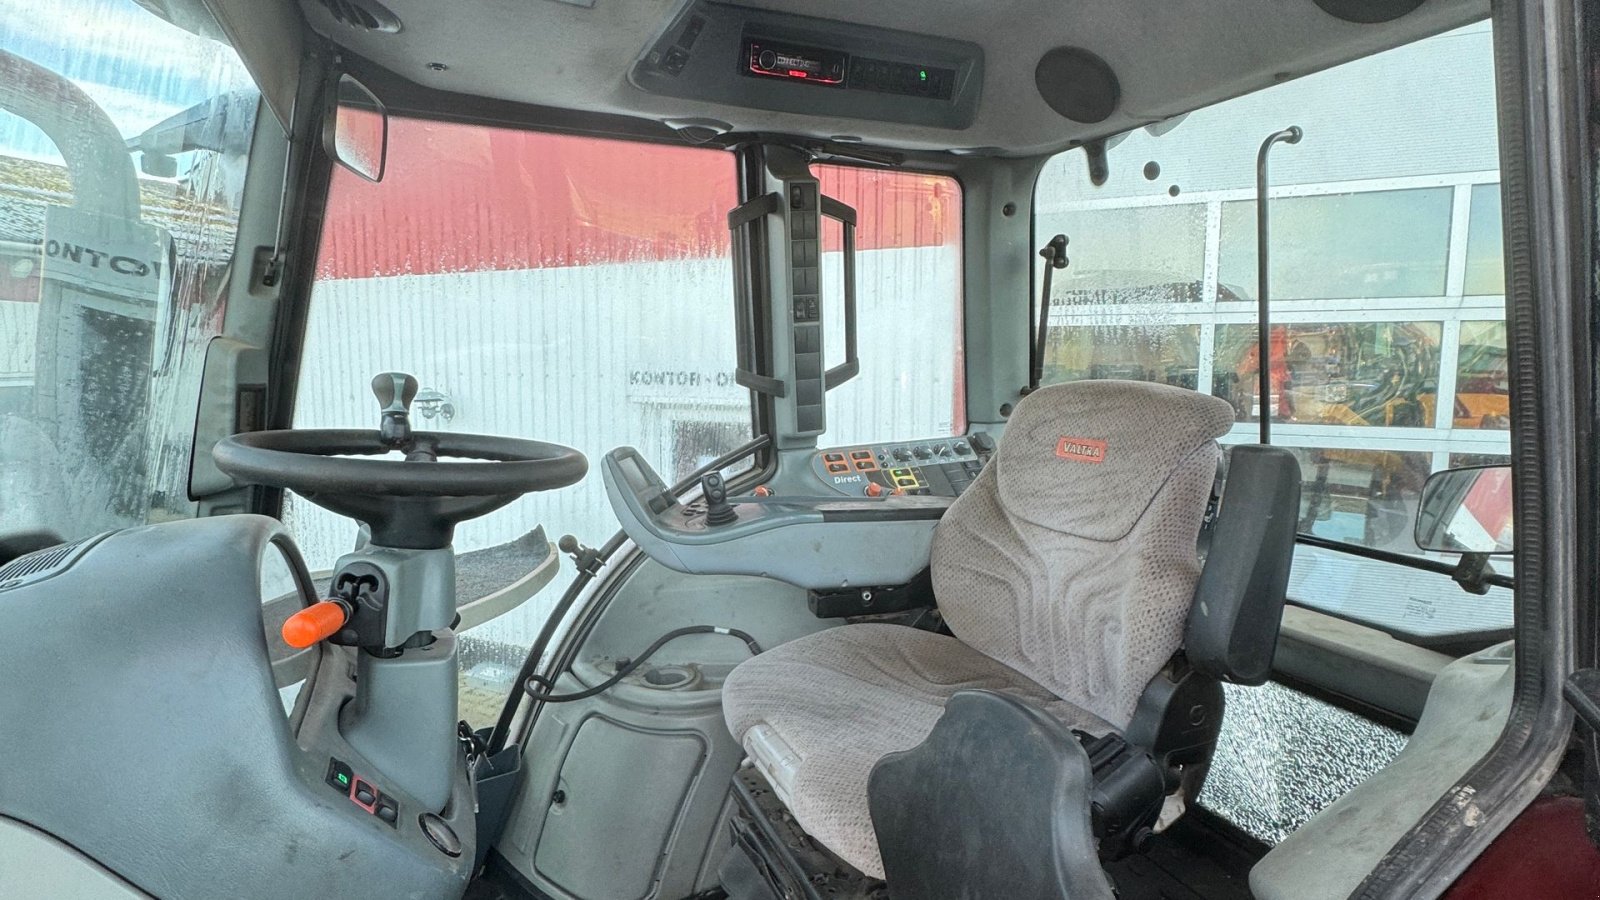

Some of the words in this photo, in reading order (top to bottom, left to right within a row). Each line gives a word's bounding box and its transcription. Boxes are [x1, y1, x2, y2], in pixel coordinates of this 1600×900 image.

[629, 371, 701, 386] KONTOR
[1063, 441, 1100, 457] VALTRA
[834, 474, 861, 484] Direct
